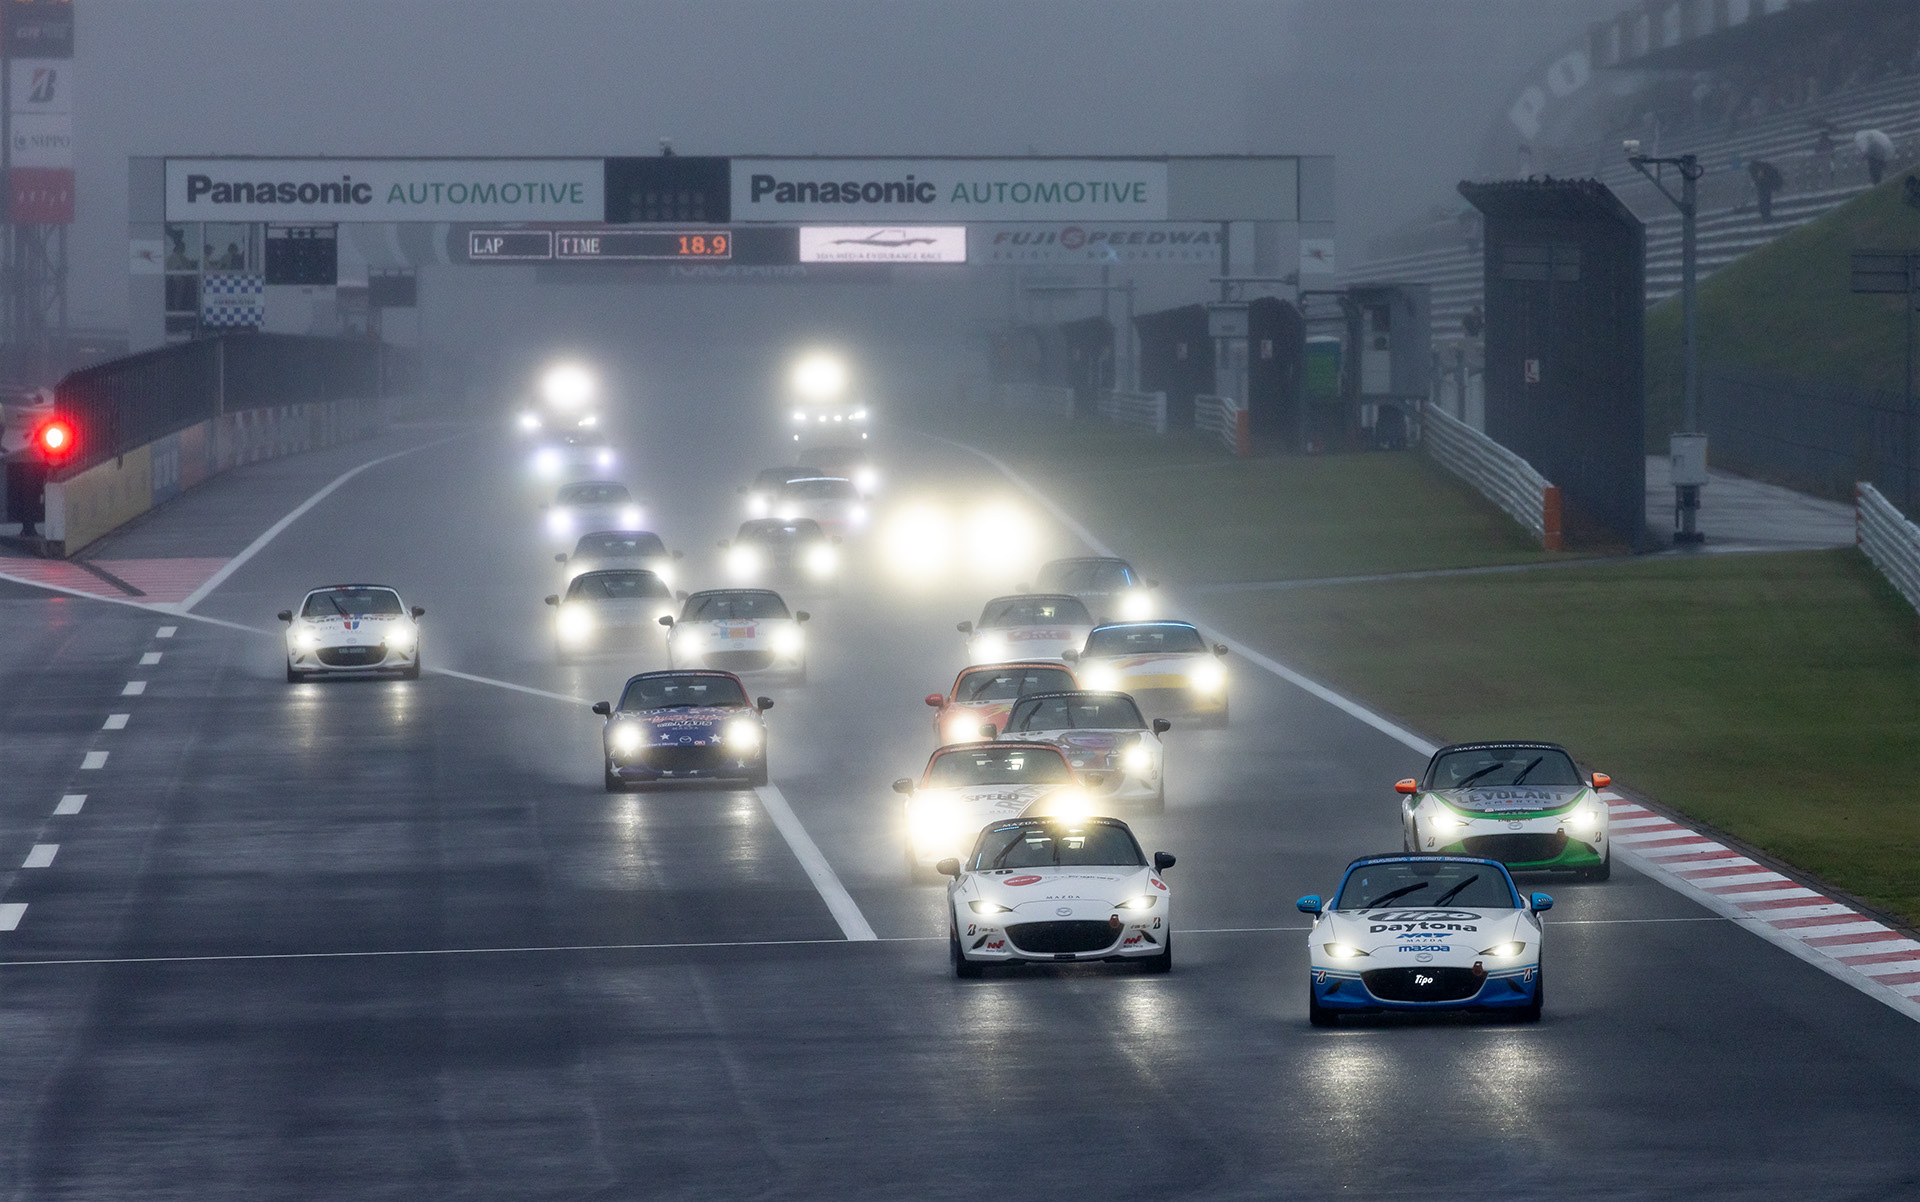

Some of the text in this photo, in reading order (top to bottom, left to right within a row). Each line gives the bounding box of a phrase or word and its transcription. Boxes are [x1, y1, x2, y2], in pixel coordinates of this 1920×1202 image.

[31, 135, 71, 148] NIPPO
[187, 174, 583, 205] Panasonic AUTOMOTIVE
[750, 174, 1147, 204] Panasonic AUTOMOTIVE
[473, 237, 503, 253] LAP
[561, 236, 727, 254] TIME 18.9
[993, 232, 1057, 245] FUJI
[1002, 820, 1038, 829] MAZDA
[1381, 910, 1476, 921] Tipo
[1369, 921, 1478, 933] Daytona
[1399, 945, 1450, 953] mazda
[1414, 974, 1434, 986] Tipo
